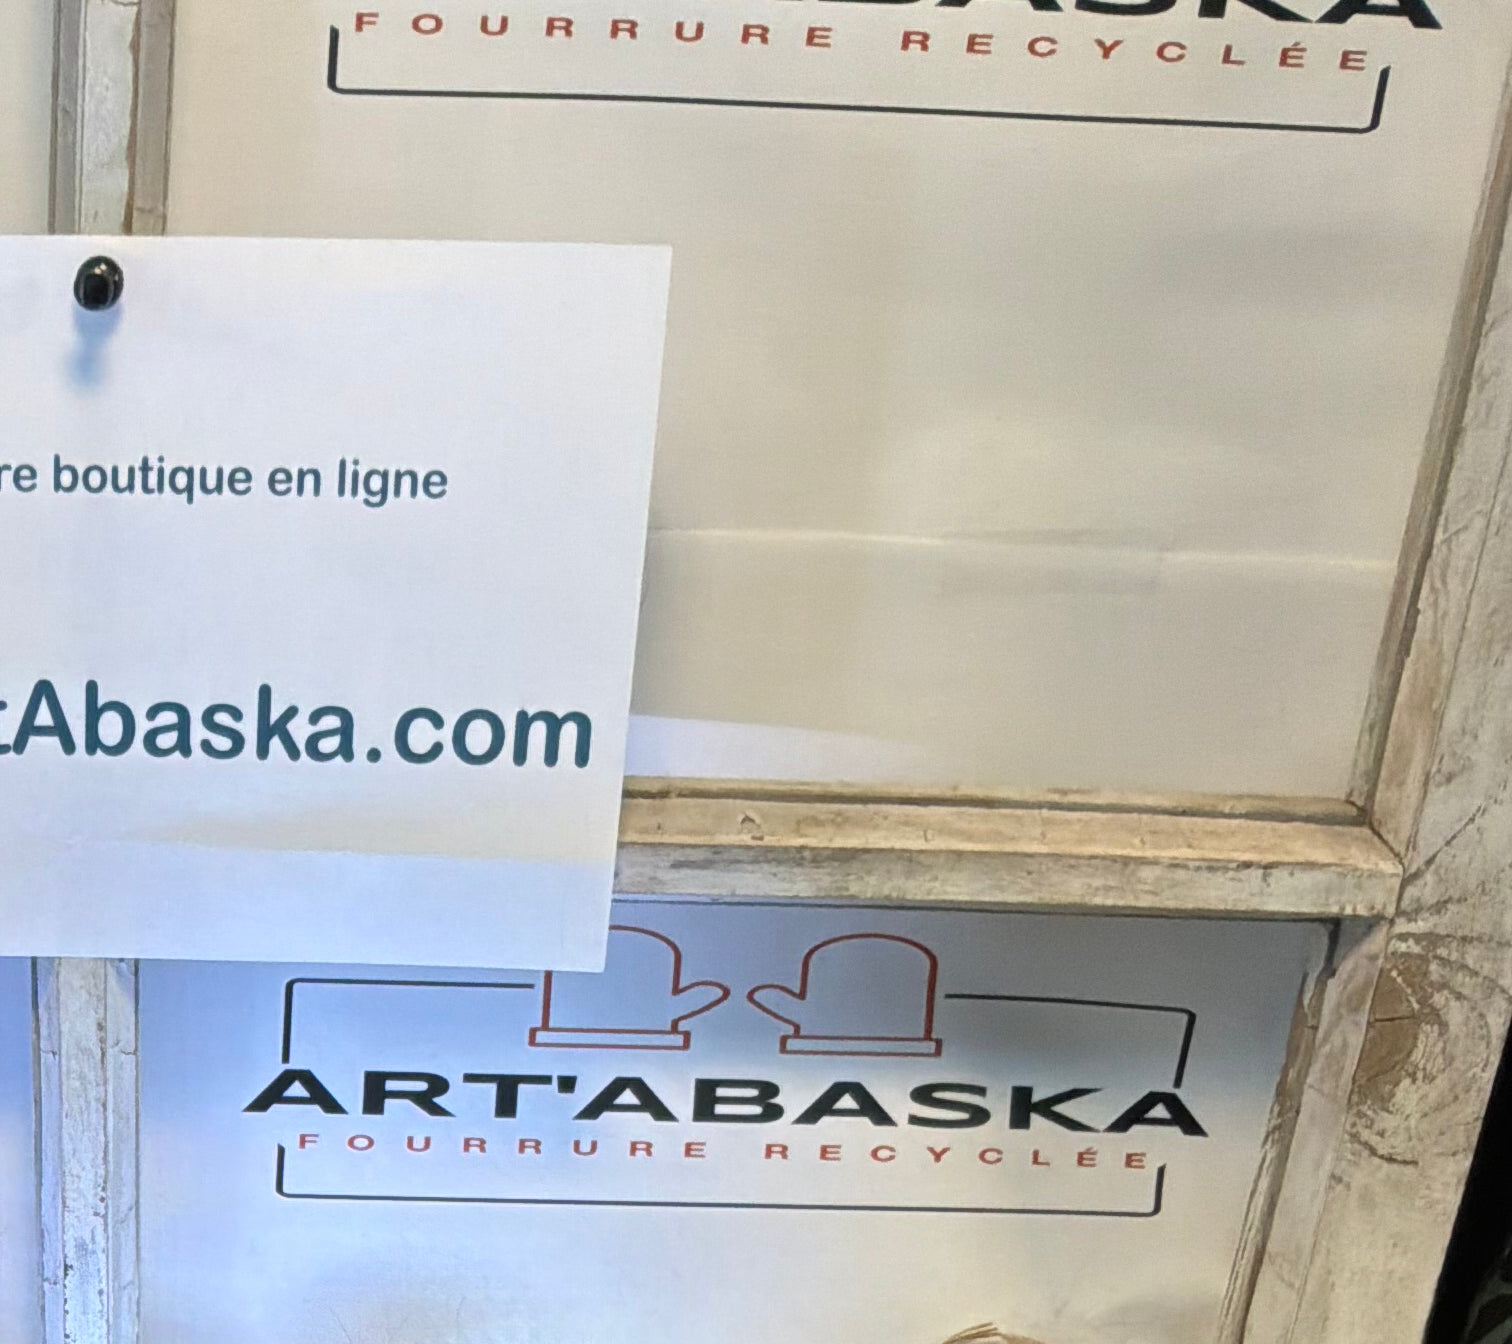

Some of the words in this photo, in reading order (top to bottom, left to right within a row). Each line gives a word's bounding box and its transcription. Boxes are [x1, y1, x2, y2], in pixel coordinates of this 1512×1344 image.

[353, 11, 832, 49] FOURRURE
[900, 30, 1364, 73] RECYCLÉE
[53, 455, 253, 503] boutique
[267, 468, 322, 496] en
[337, 459, 448, 508] ligne
[242, 1067, 1210, 1139] ART'ABASKA
[299, 1132, 707, 1159] FOURRURE
[763, 1142, 1147, 1171] RECYCLÉE
